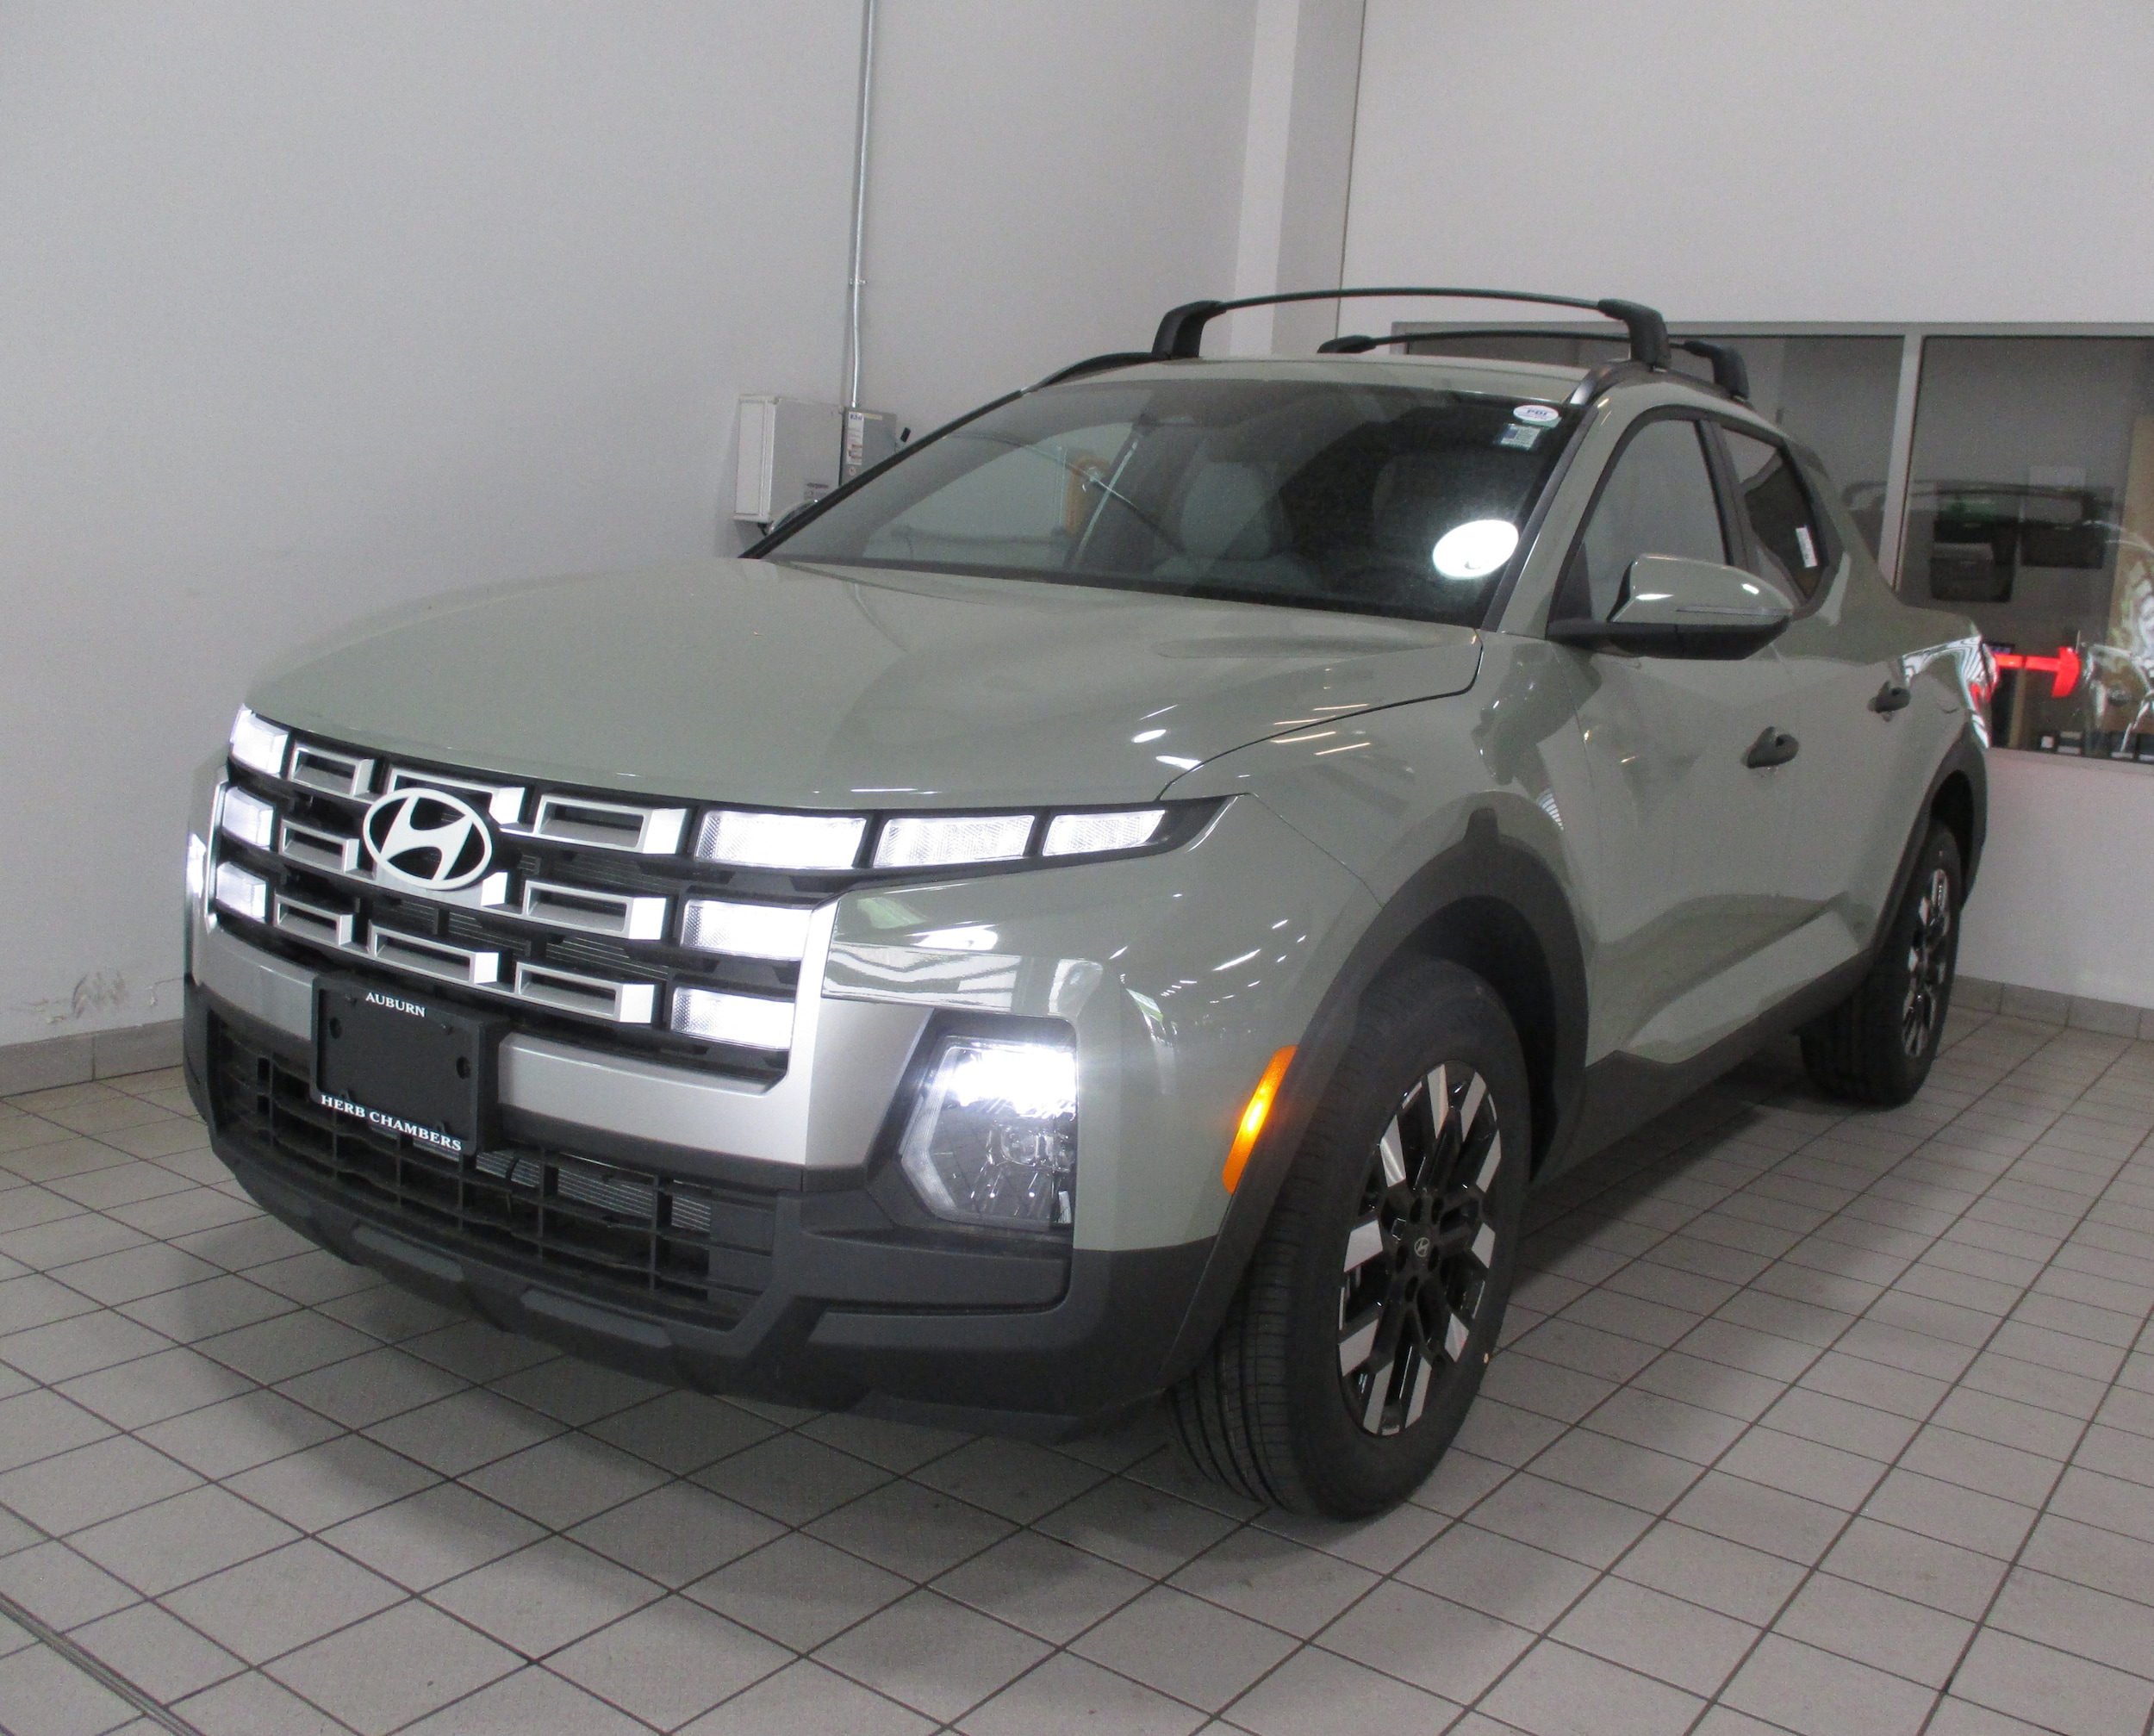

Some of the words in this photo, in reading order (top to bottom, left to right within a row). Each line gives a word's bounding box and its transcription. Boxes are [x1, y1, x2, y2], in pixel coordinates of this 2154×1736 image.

[365, 992, 426, 1017] AUBURN
[321, 1094, 365, 1118] HERB
[369, 1111, 462, 1151] CHAMBERS
